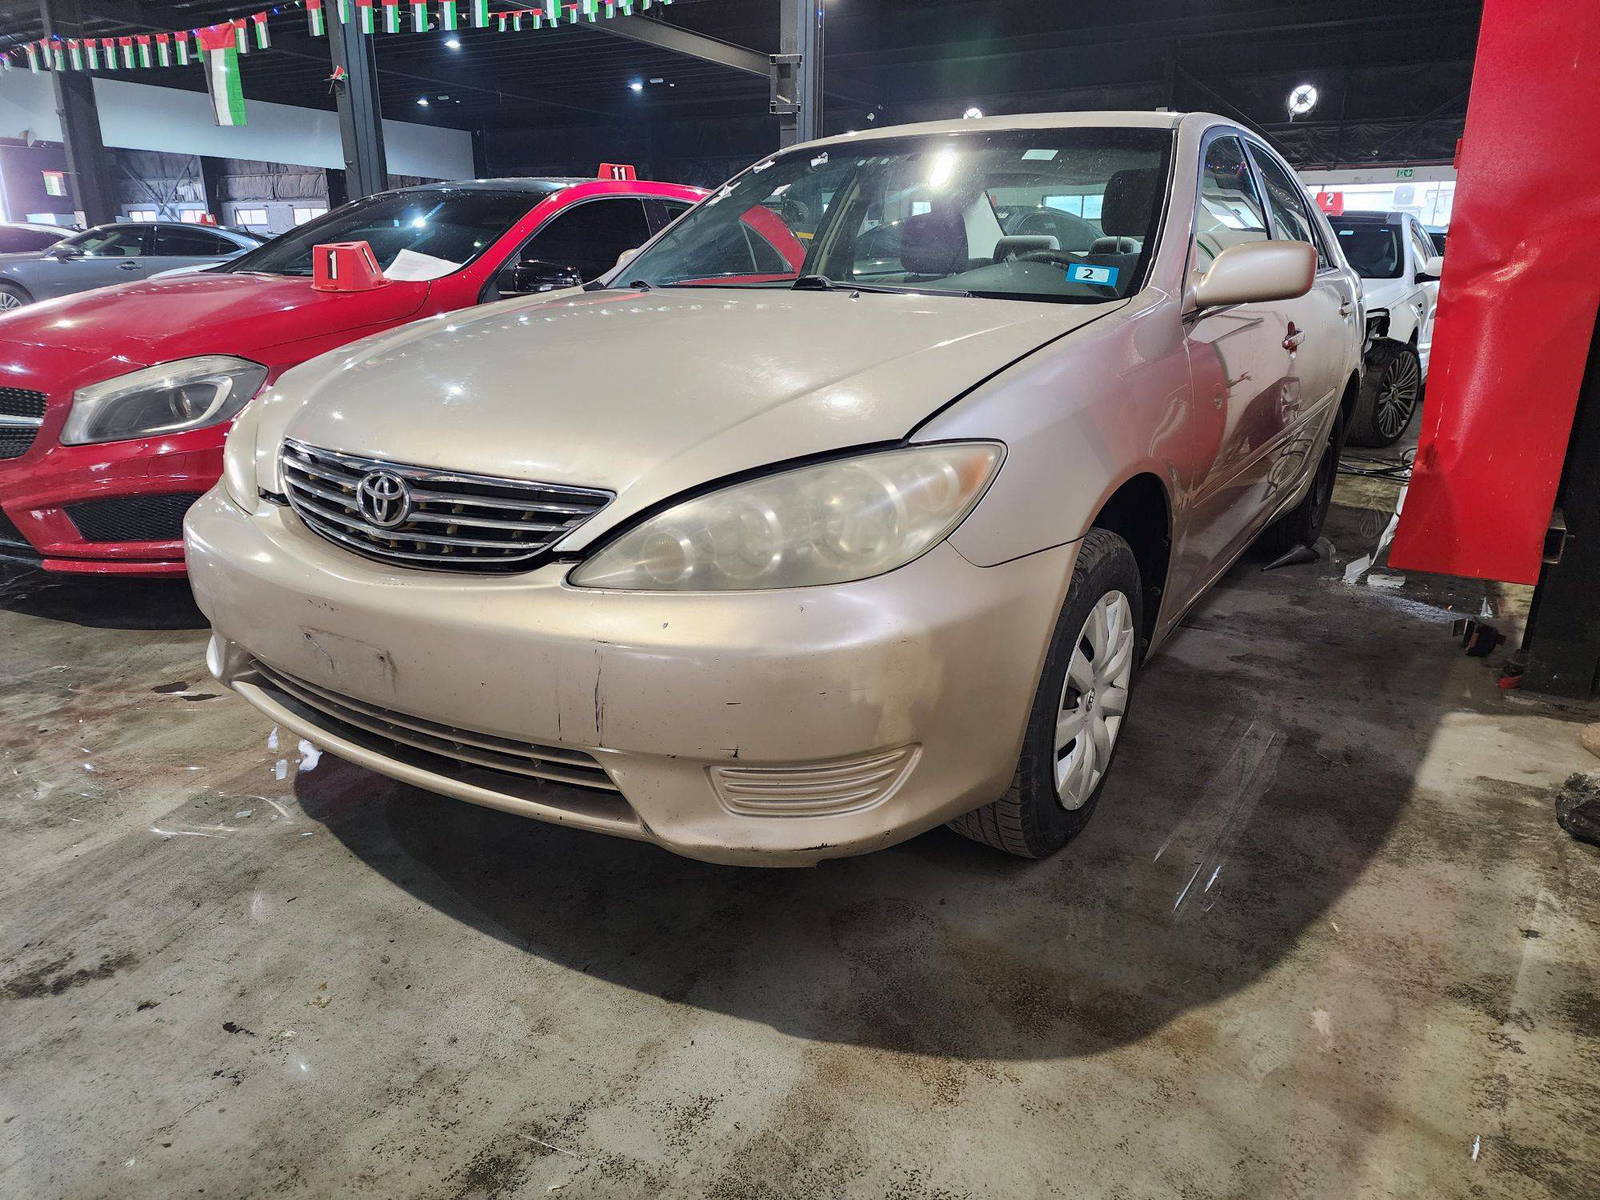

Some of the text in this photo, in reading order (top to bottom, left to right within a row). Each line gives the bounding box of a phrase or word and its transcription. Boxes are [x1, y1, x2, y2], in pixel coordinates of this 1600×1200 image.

[613, 166, 627, 180] 11
[1325, 192, 1335, 206] 2
[329, 250, 338, 280] 1
[1082, 268, 1094, 280] 2
